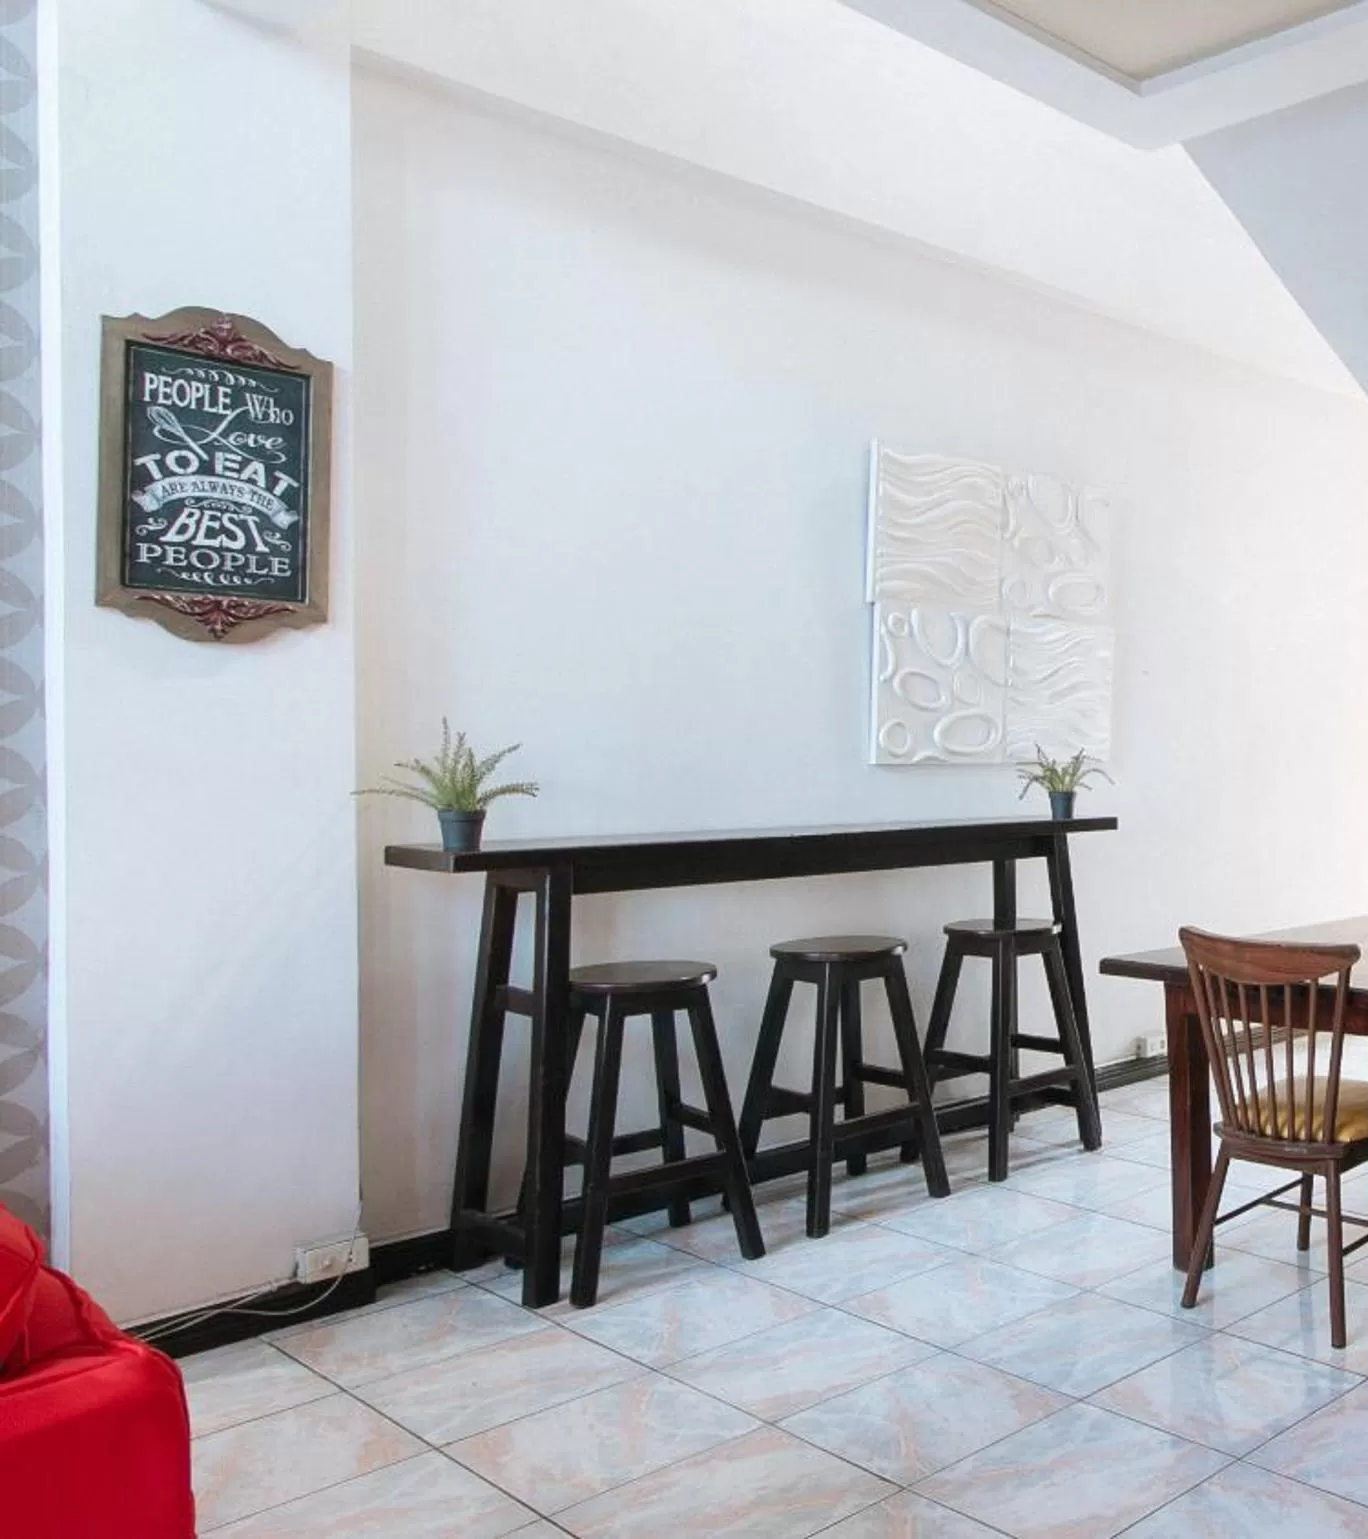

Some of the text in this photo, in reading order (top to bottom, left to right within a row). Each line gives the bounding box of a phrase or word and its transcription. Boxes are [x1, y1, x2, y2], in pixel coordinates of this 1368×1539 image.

[143, 372, 294, 426] PEOPLE Who
[133, 449, 300, 497] TO EAT
[161, 480, 274, 512] ARE ALWAYS THE
[159, 507, 270, 553] BEST
[135, 543, 292, 577] PEOPLE
